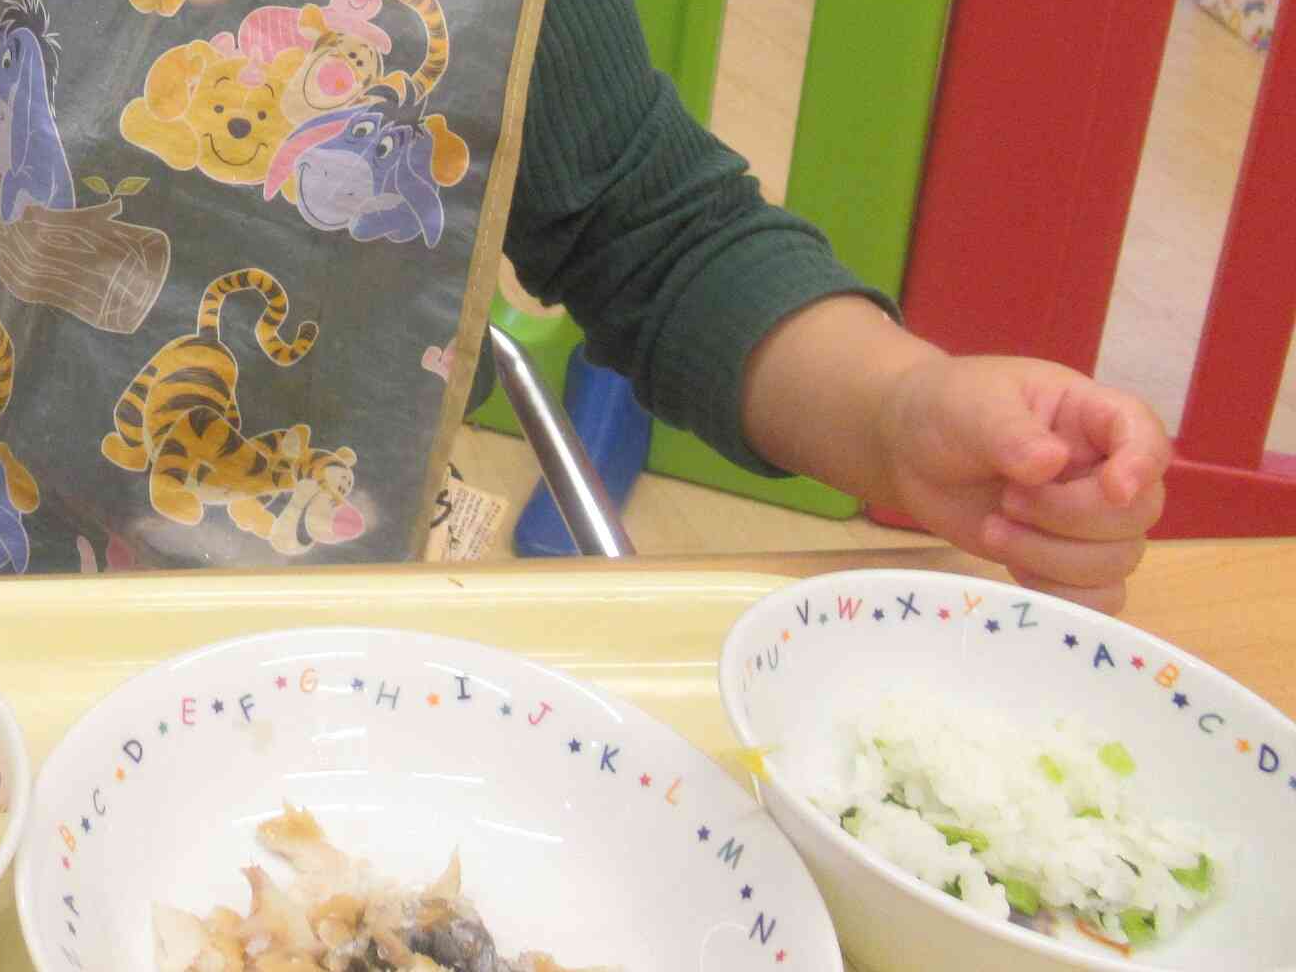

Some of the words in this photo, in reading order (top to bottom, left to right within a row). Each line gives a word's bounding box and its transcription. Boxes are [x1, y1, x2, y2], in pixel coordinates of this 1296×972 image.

[767, 644, 779, 671] U
[796, 598, 809, 626] V
[837, 595, 863, 621] W
[896, 592, 921, 620] X
[962, 592, 983, 616] Y
[1011, 602, 1038, 629] Z
[1093, 642, 1116, 669] A
[1154, 663, 1180, 689] B
[1198, 712, 1225, 734] C
[1258, 743, 1280, 774] D
[93, 788, 106, 816] C
[122, 739, 143, 765] D
[181, 697, 197, 725] E
[239, 694, 255, 723] F
[299, 668, 319, 693] G
[375, 681, 401, 710] H
[455, 676, 471, 701] I
[527, 701, 553, 726] J
[600, 744, 620, 774] K
[665, 778, 683, 806] L
[716, 837, 744, 871] M
[749, 912, 777, 946] N
